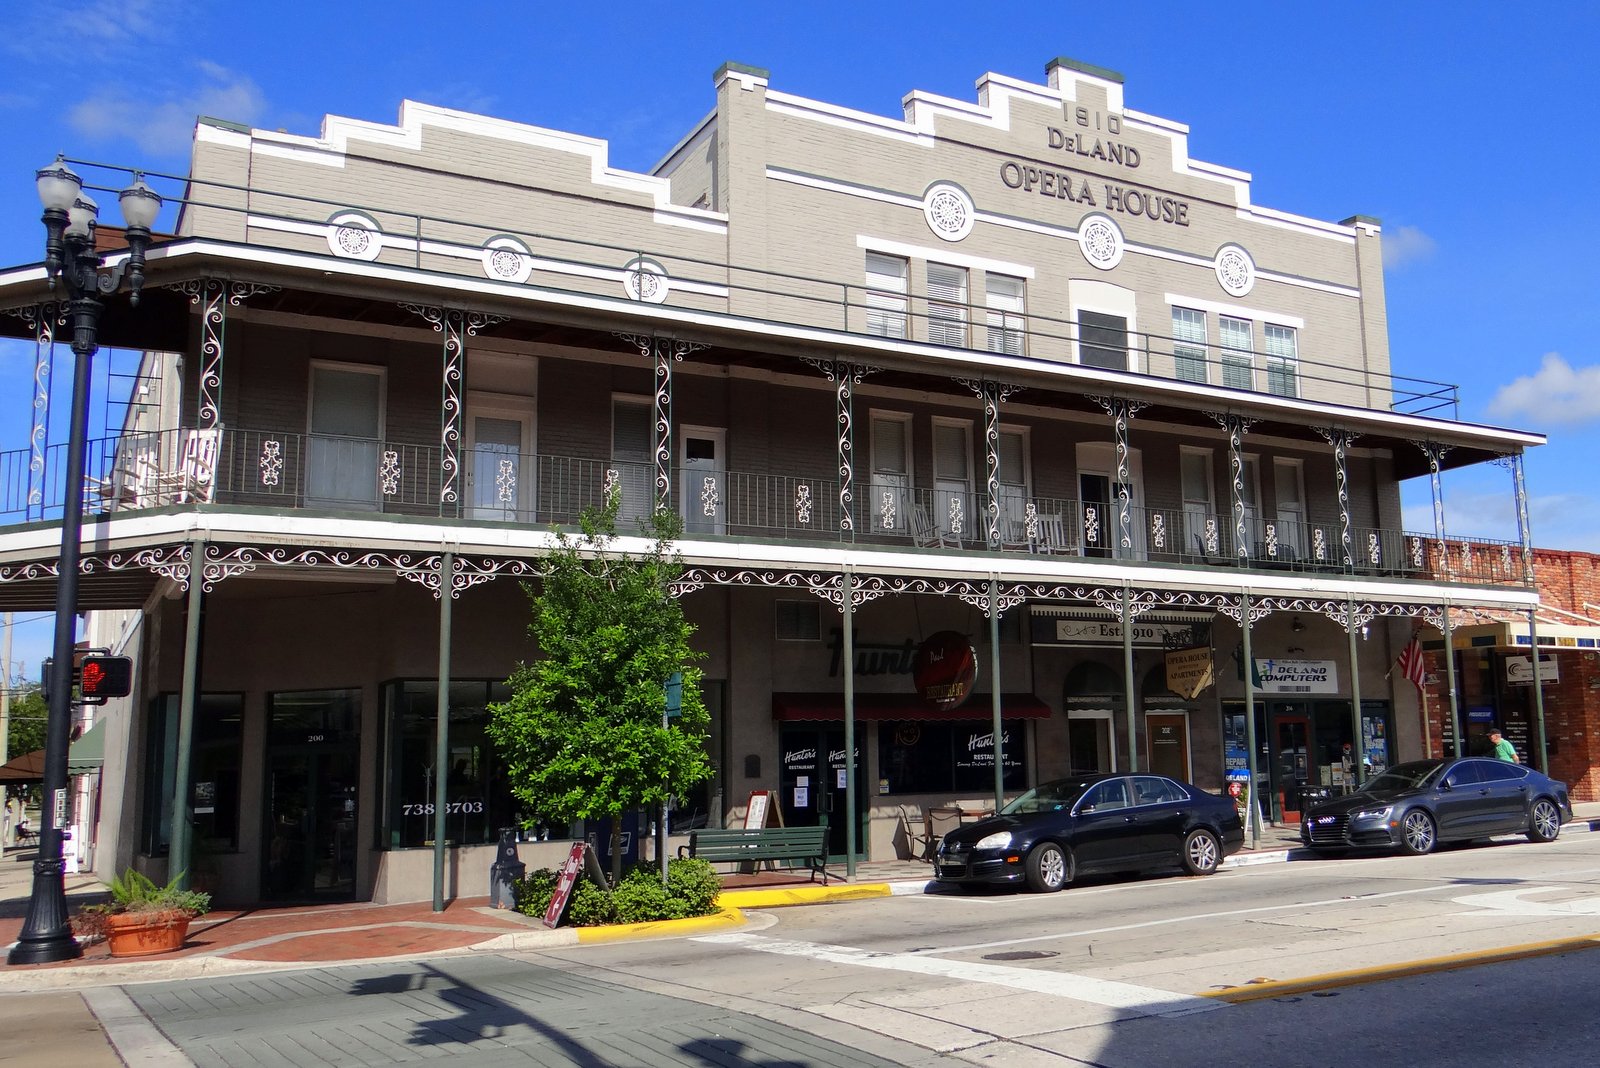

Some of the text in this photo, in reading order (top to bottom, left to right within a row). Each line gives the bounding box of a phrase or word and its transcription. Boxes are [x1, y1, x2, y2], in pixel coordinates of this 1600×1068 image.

[1063, 102, 1121, 135] 1910
[1000, 160, 1190, 227] OPERA HOUSE
[1099, 624, 1154, 641] Est. 910
[1188, 652, 1209, 662] HOUSE
[1278, 666, 1327, 674] DELAND
[1260, 674, 1328, 682] COMPUTERS
[307, 734, 324, 742] 200
[968, 730, 1010, 751] Hunt's
[1225, 757, 1247, 766] REPAIR
